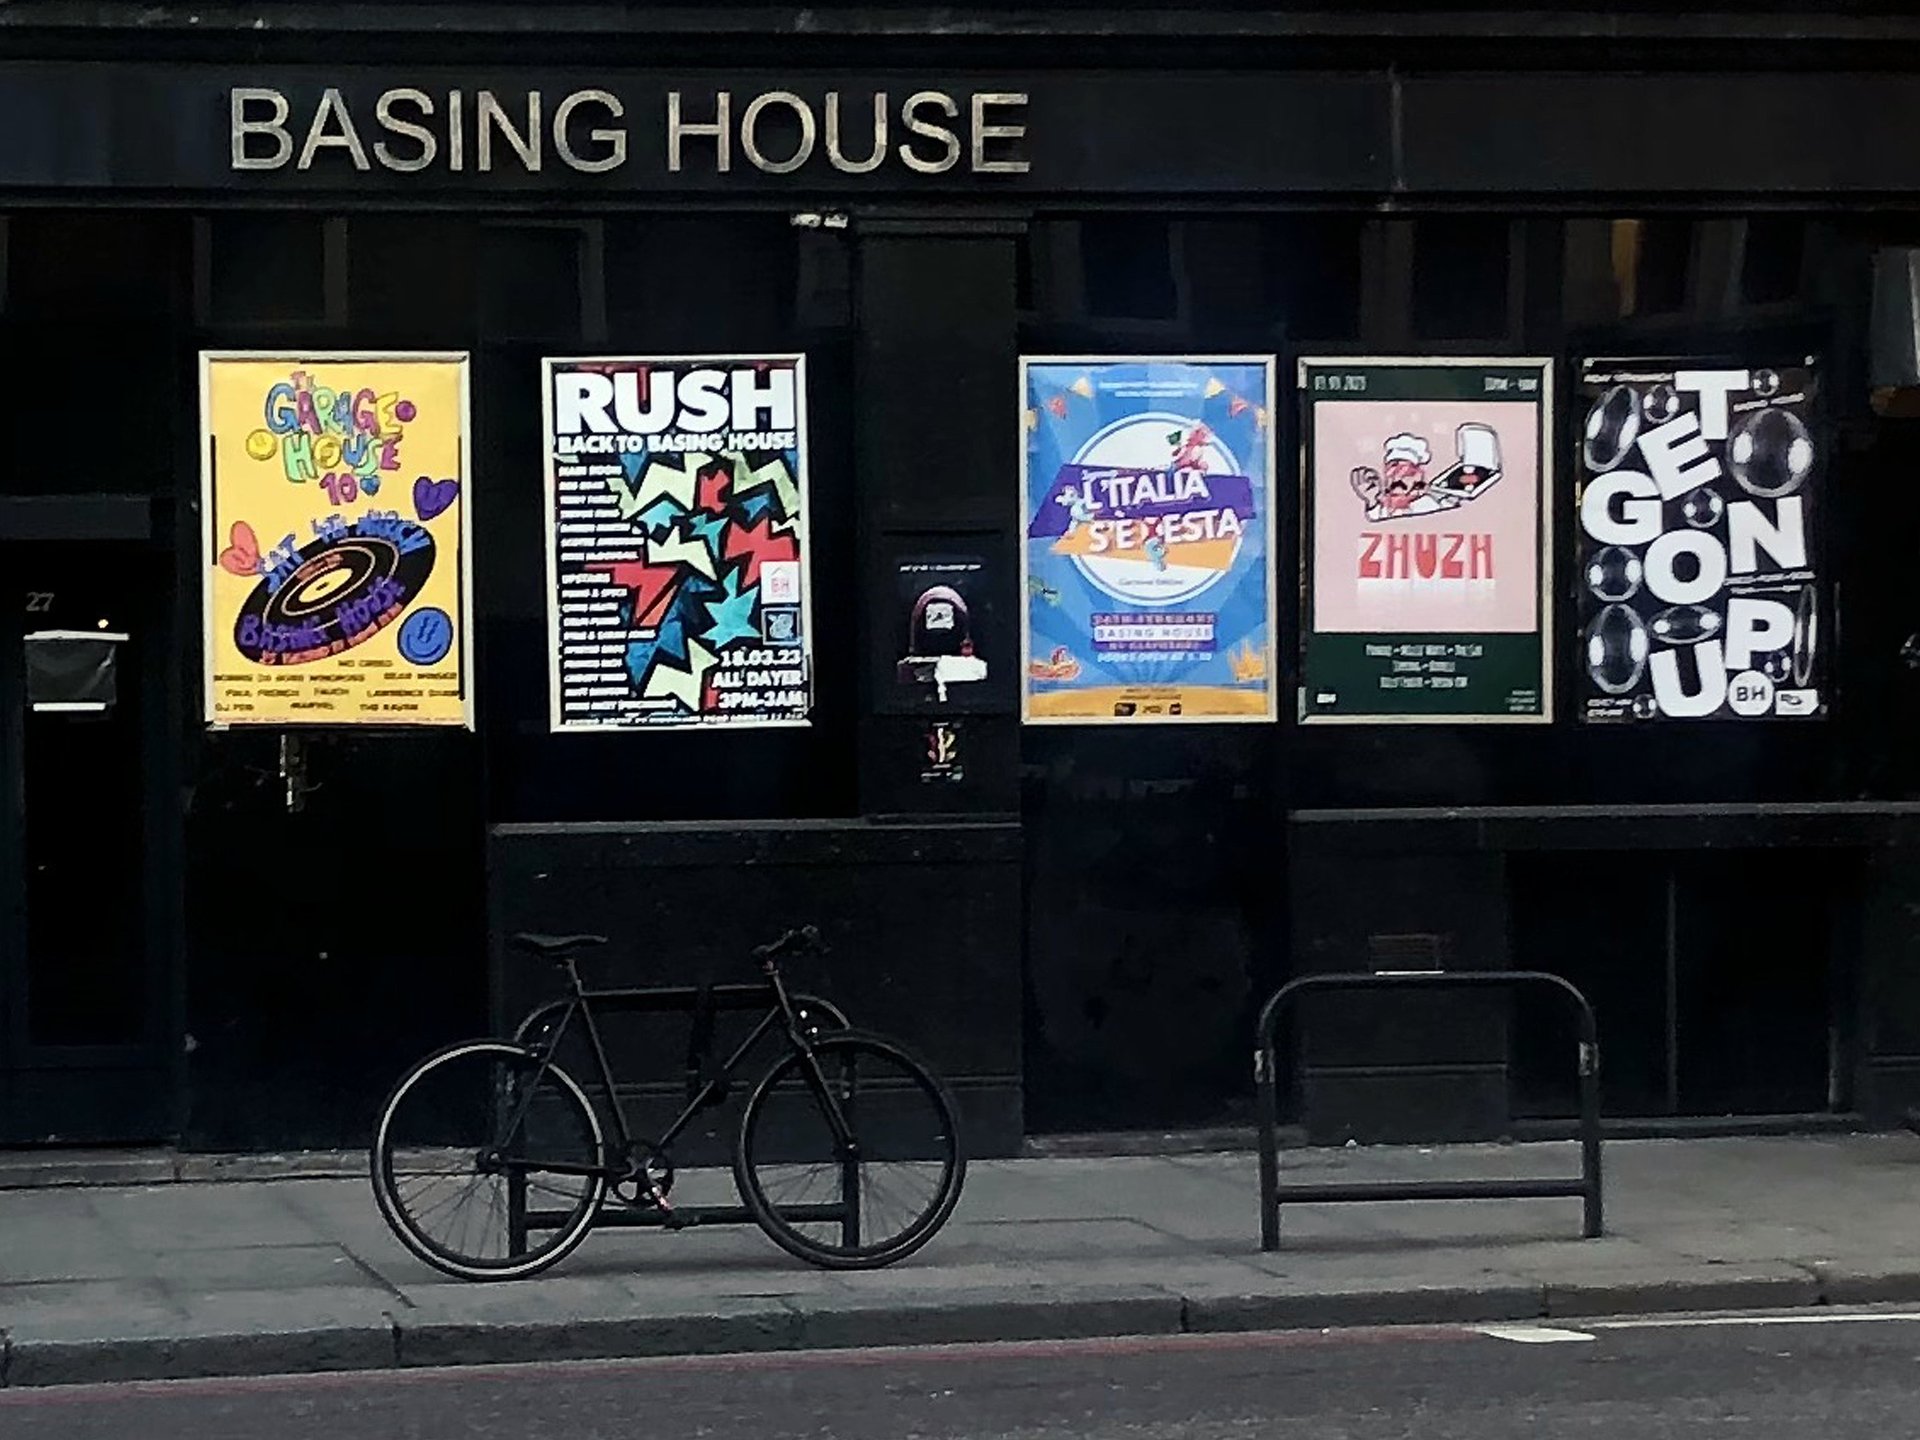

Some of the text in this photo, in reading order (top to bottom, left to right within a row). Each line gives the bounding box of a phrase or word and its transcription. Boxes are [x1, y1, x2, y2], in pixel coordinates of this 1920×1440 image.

[231, 87, 1031, 174] BASING HOUSE
[265, 382, 403, 438] GARAGE
[555, 369, 796, 434] RUSH
[283, 431, 403, 483] HOUSE
[558, 431, 796, 453] BACK TO BASING HOUSE
[319, 472, 358, 506] 10
[1080, 467, 1210, 511] L'ITALIA
[1357, 532, 1494, 579] ZHUZH
[25, 591, 55, 612] 27
[1096, 627, 1211, 639] BASING HOUSE
[719, 649, 801, 668] 18.03.23
[712, 671, 744, 688] ALL
[1736, 686, 1766, 702] BH
